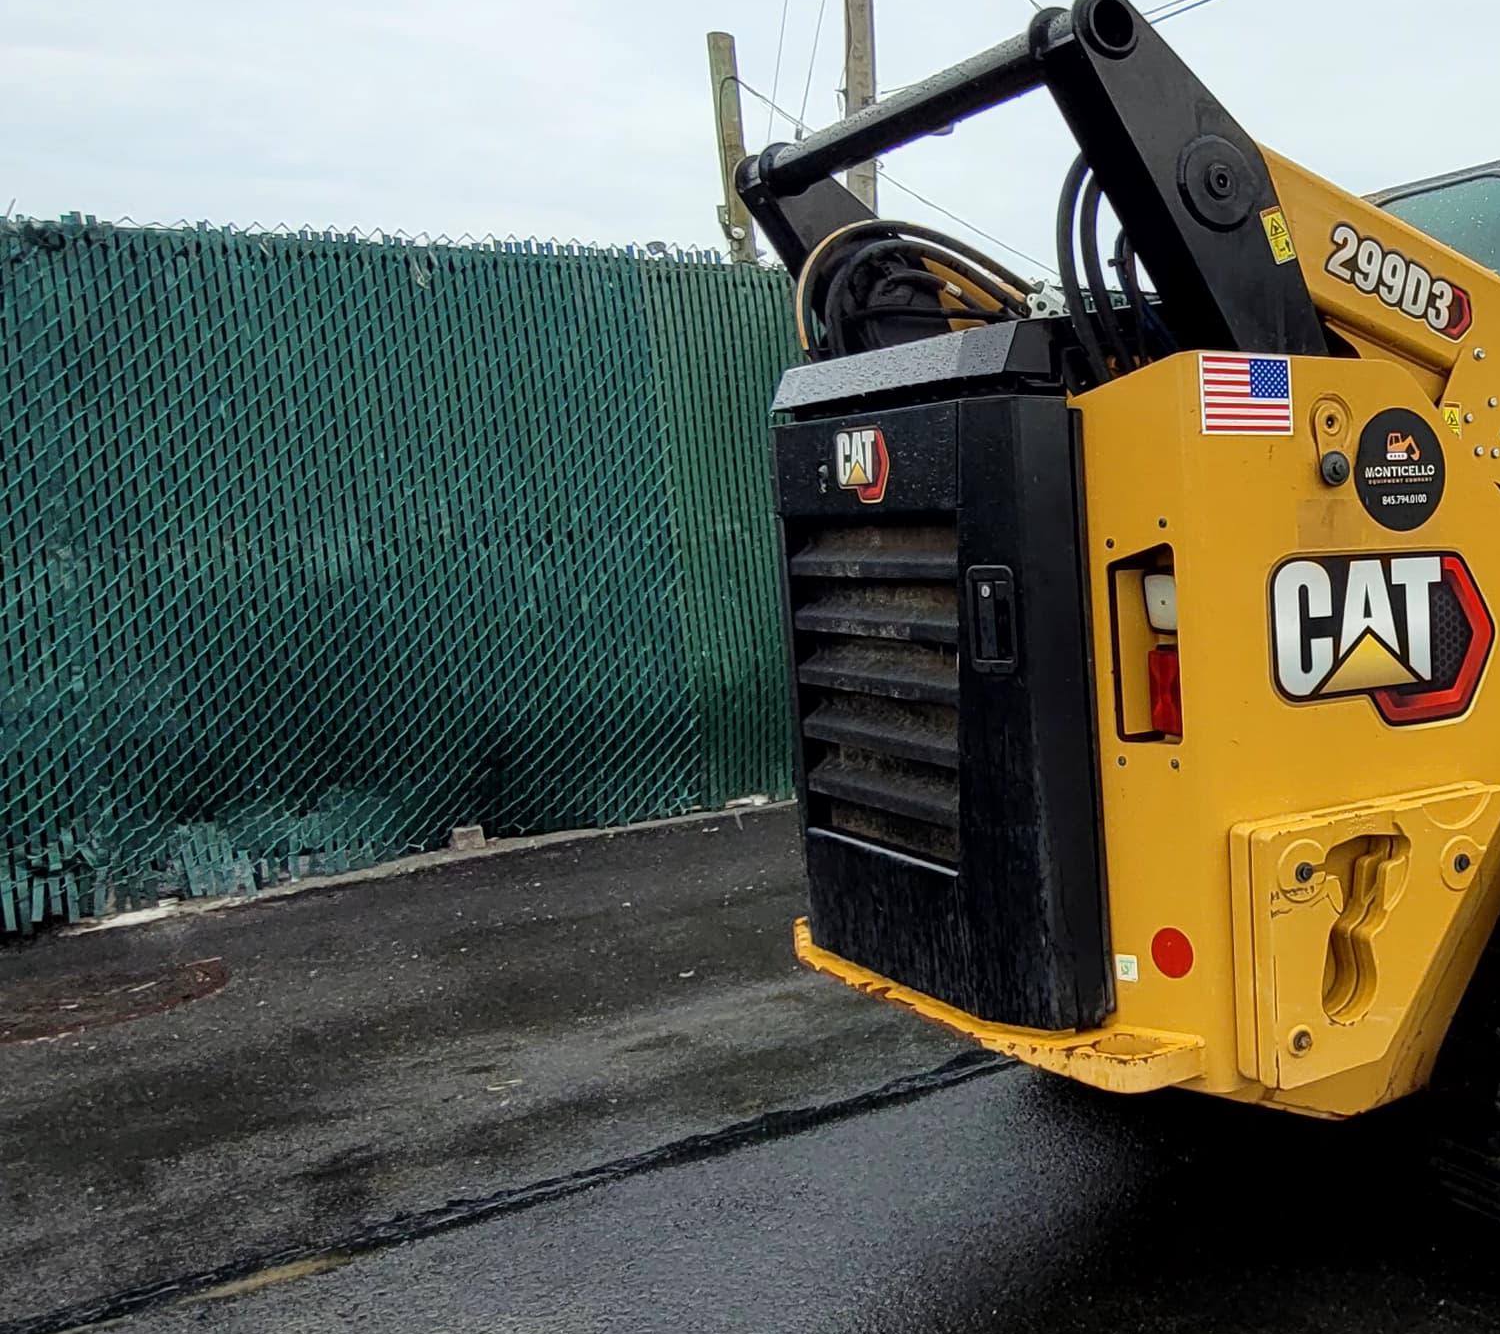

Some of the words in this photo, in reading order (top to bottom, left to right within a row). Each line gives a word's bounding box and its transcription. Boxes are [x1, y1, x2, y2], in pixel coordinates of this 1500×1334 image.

[1327, 226, 1453, 329] 299D3
[837, 430, 875, 485] CAT
[1364, 464, 1435, 478] MONTICELLO
[1274, 556, 1441, 696] CAT
